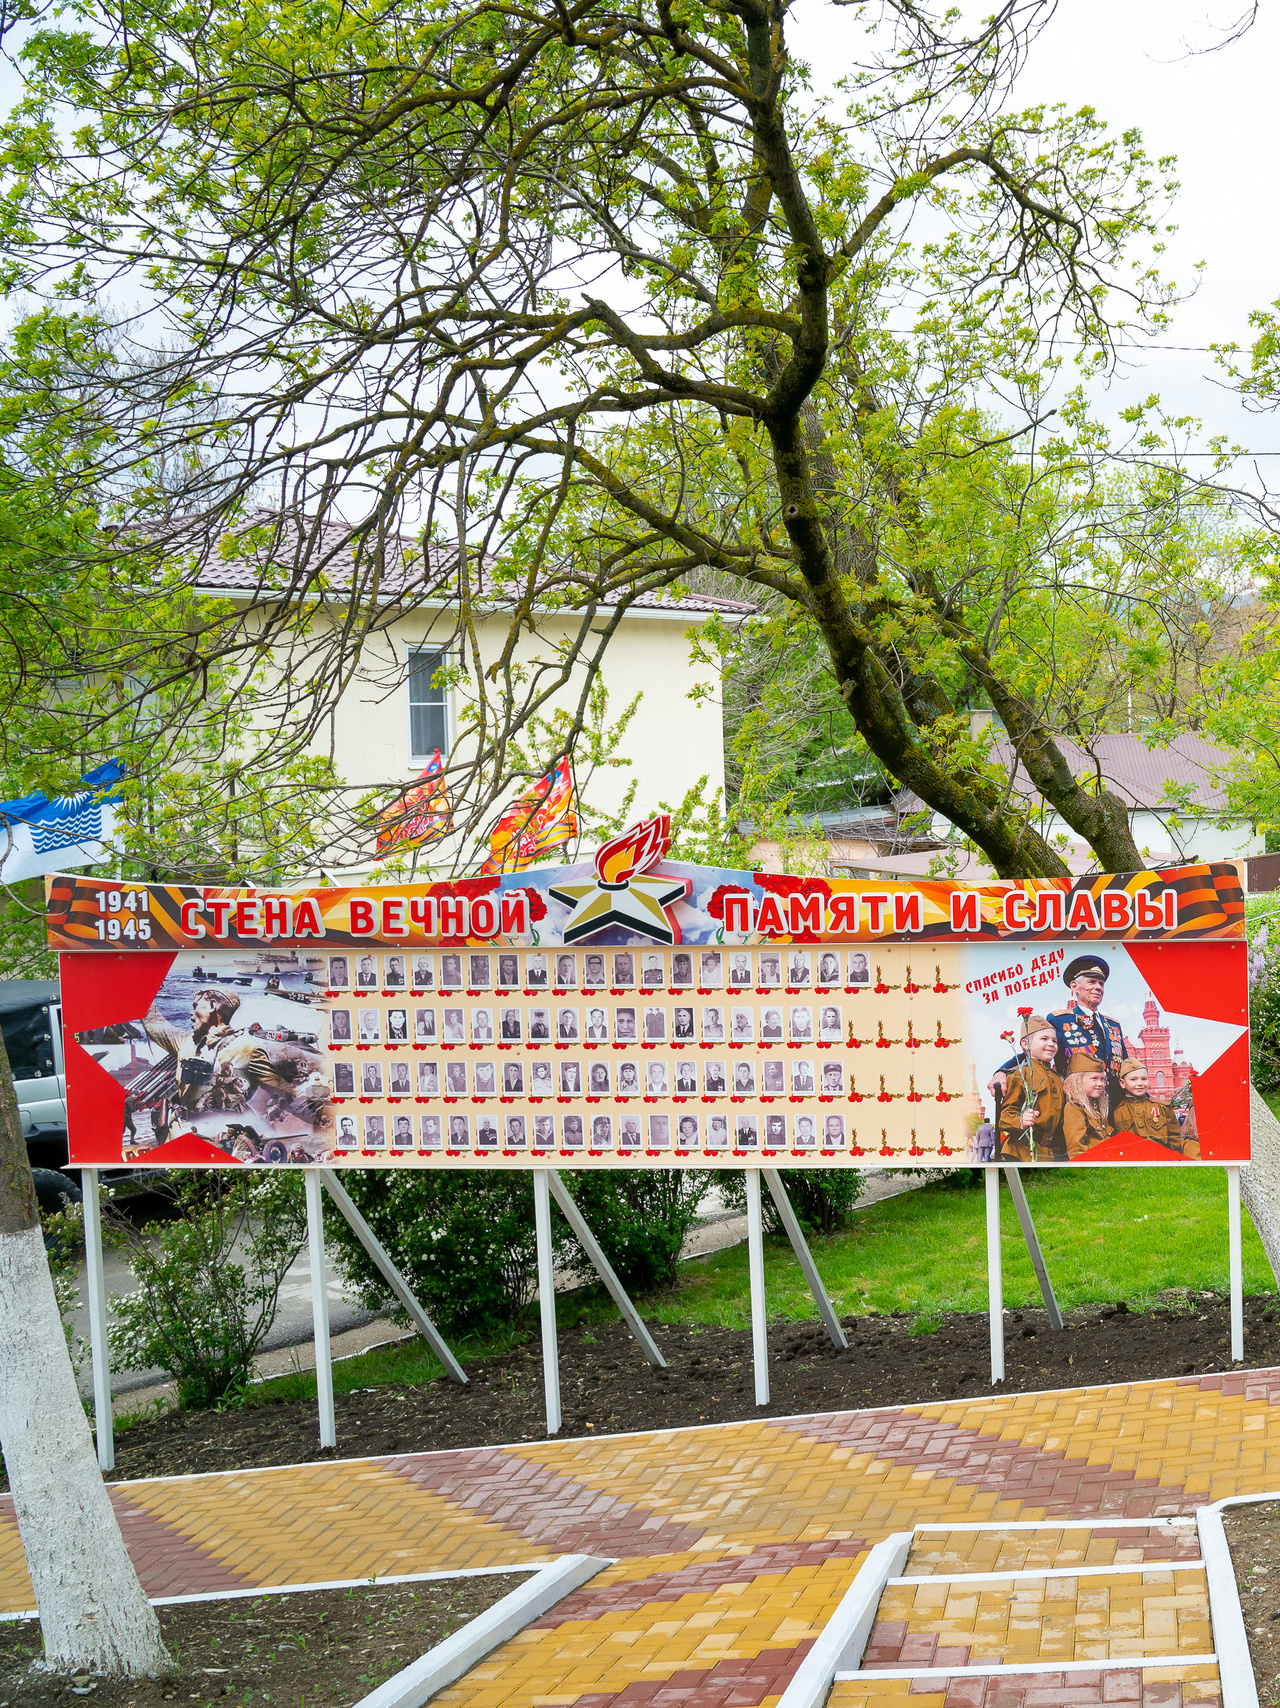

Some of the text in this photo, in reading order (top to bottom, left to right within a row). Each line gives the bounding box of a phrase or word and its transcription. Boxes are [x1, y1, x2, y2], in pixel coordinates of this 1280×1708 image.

[95, 890, 149, 912] 1941
[181, 889, 1177, 937] СТЕНА ВЕЧНОЙ ПАМЯТИ И СЛАВЫ
[95, 919, 150, 940] 1945
[966, 948, 1064, 993] СПАСИБО ДЕДУ
[983, 966, 1060, 1004] ЗА ПОБЕДУ!
